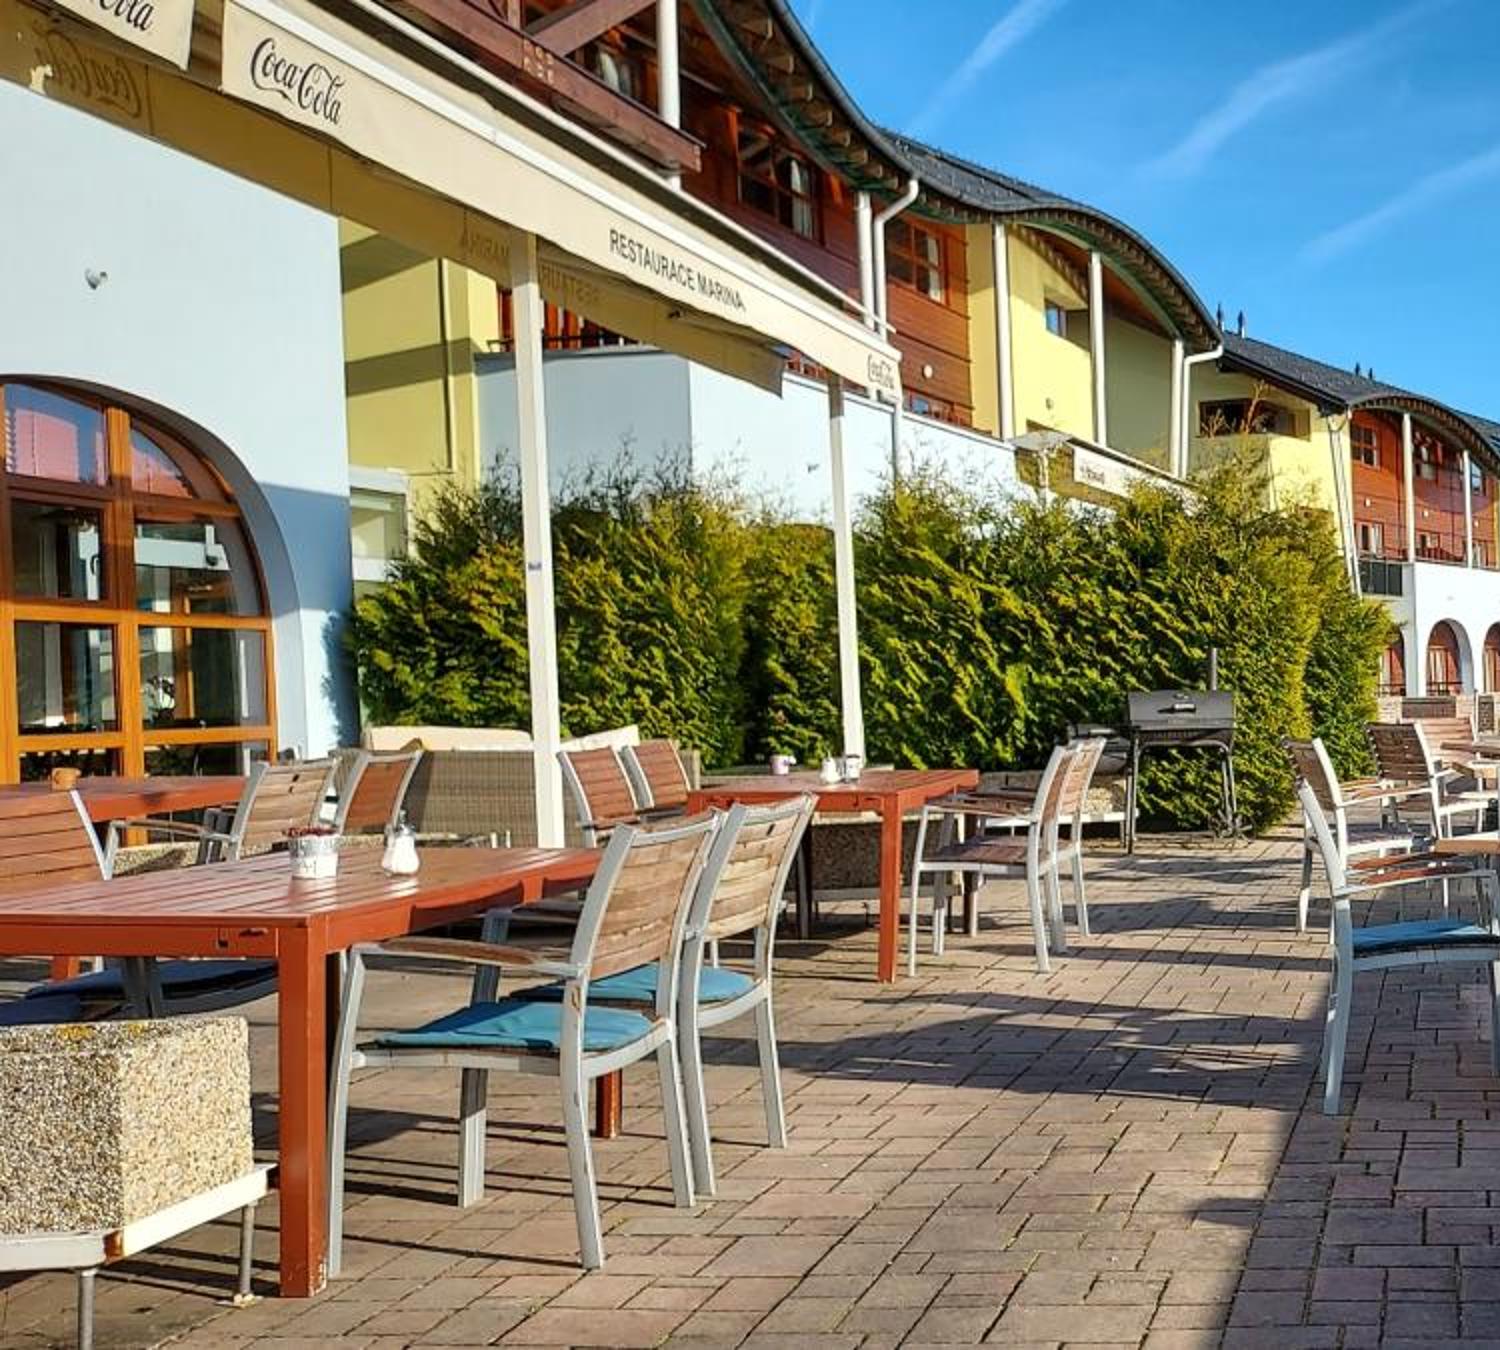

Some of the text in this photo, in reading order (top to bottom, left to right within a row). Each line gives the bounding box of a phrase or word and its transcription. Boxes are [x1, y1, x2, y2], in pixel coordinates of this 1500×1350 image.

[250, 37, 346, 125] Coca-Cola
[609, 228, 747, 312] RESTAURACE MARINA
